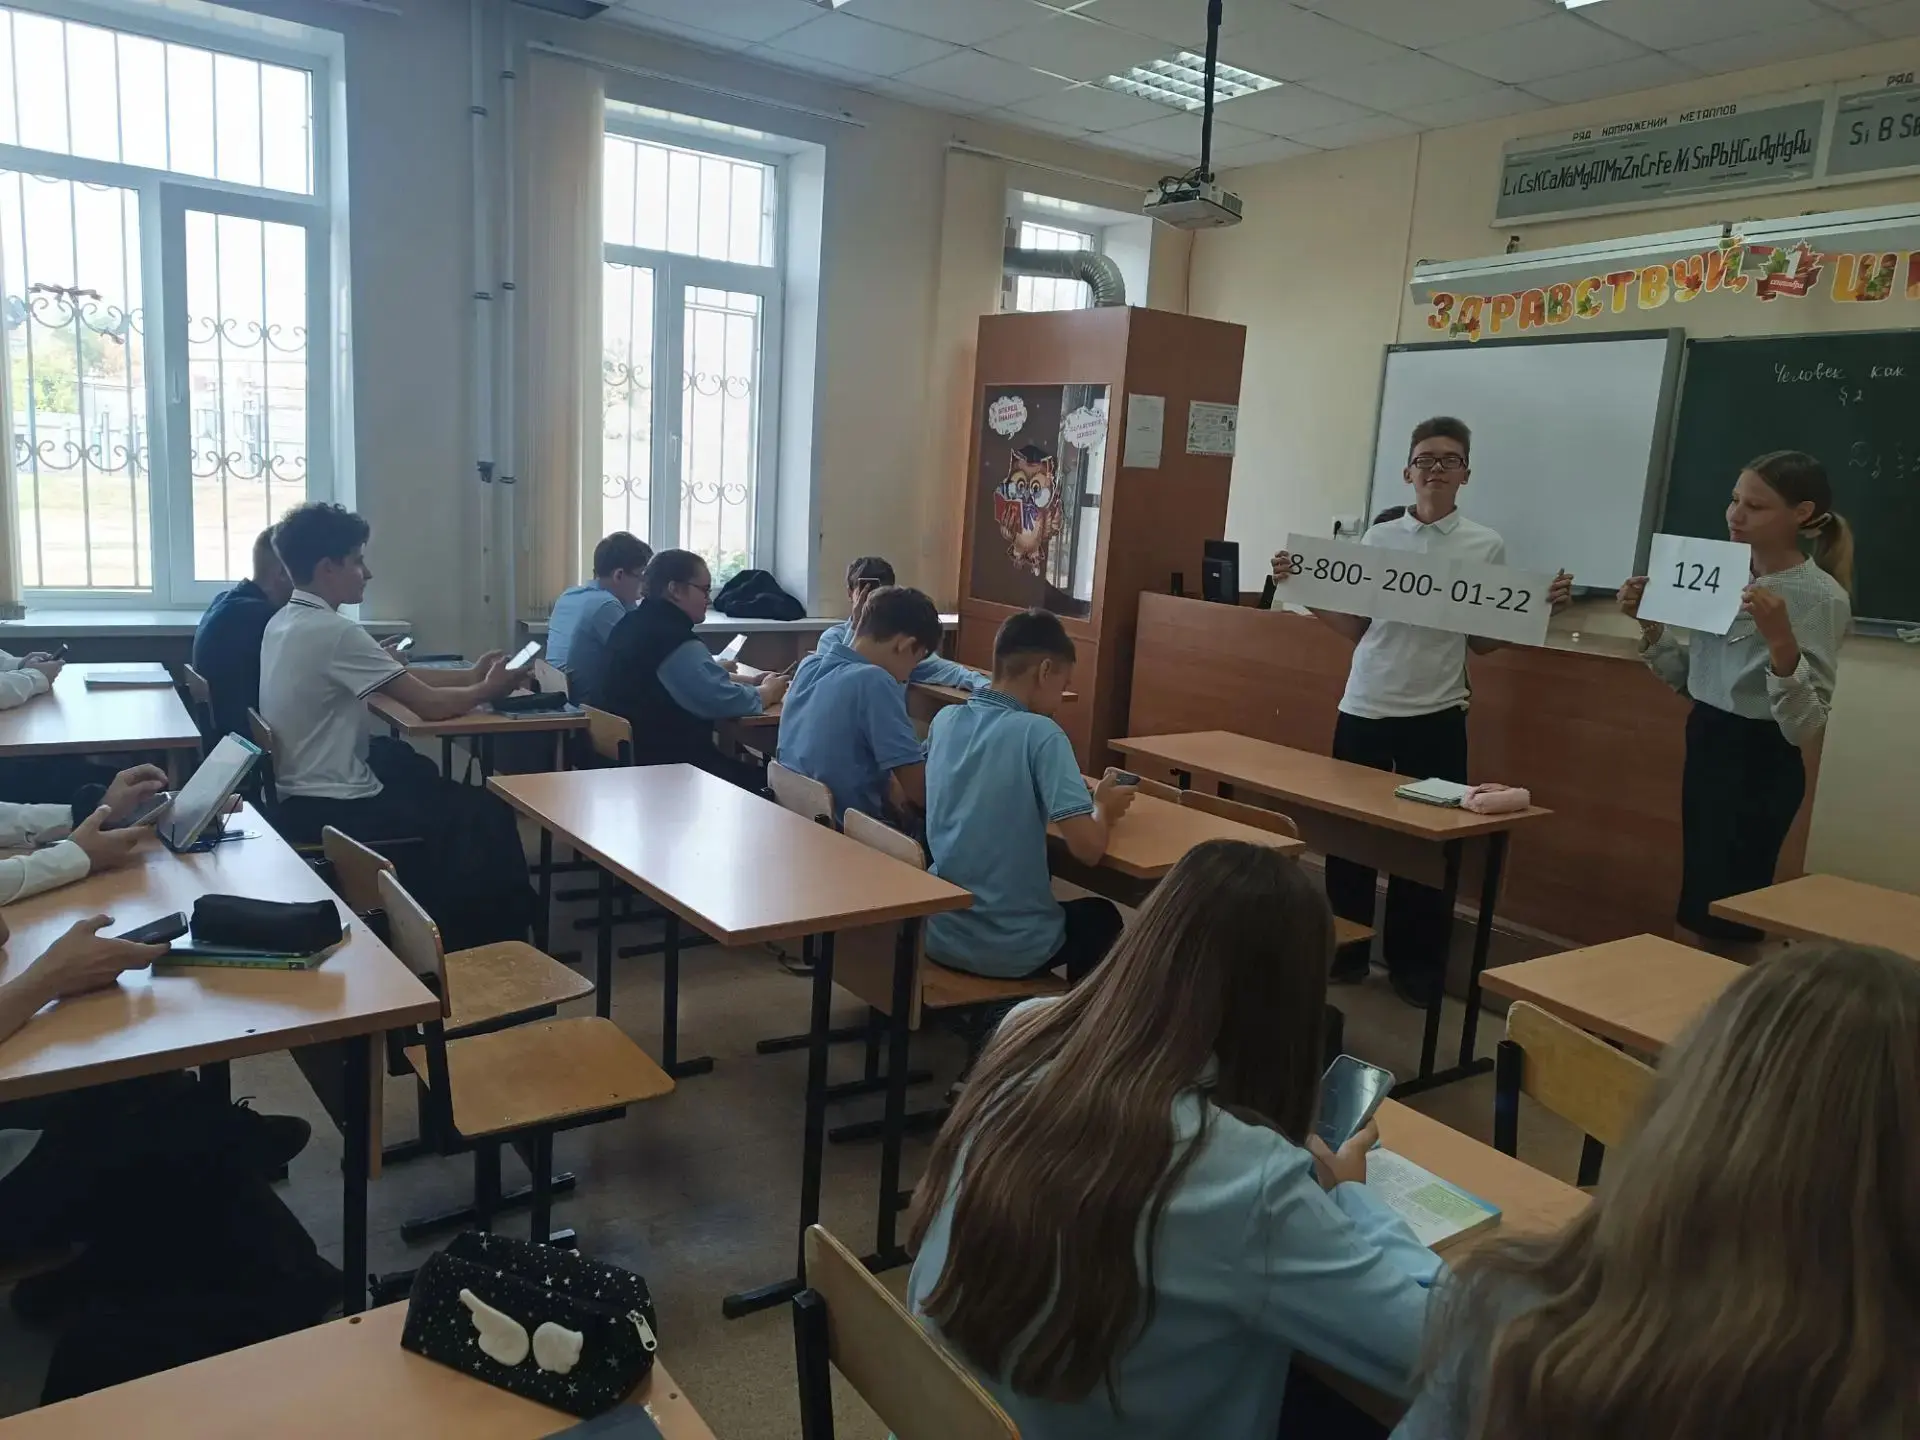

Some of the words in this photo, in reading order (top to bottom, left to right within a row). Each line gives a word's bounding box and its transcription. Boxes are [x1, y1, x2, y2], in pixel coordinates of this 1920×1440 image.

[1886, 71, 1914, 87] РЯД
[1572, 130, 1592, 142] РЯД
[1849, 120, 1870, 146] Si
[1427, 235, 1749, 342] ЗДРАВСТВУЙ
[1831, 252, 1920, 303] Ш
[1774, 362, 1847, 383] Человек
[1870, 365, 1905, 379] как
[1288, 553, 1372, 586] 8-800-
[1382, 568, 1442, 596] 200-
[1451, 580, 1531, 613] 01-22
[1672, 561, 1721, 595] 124
